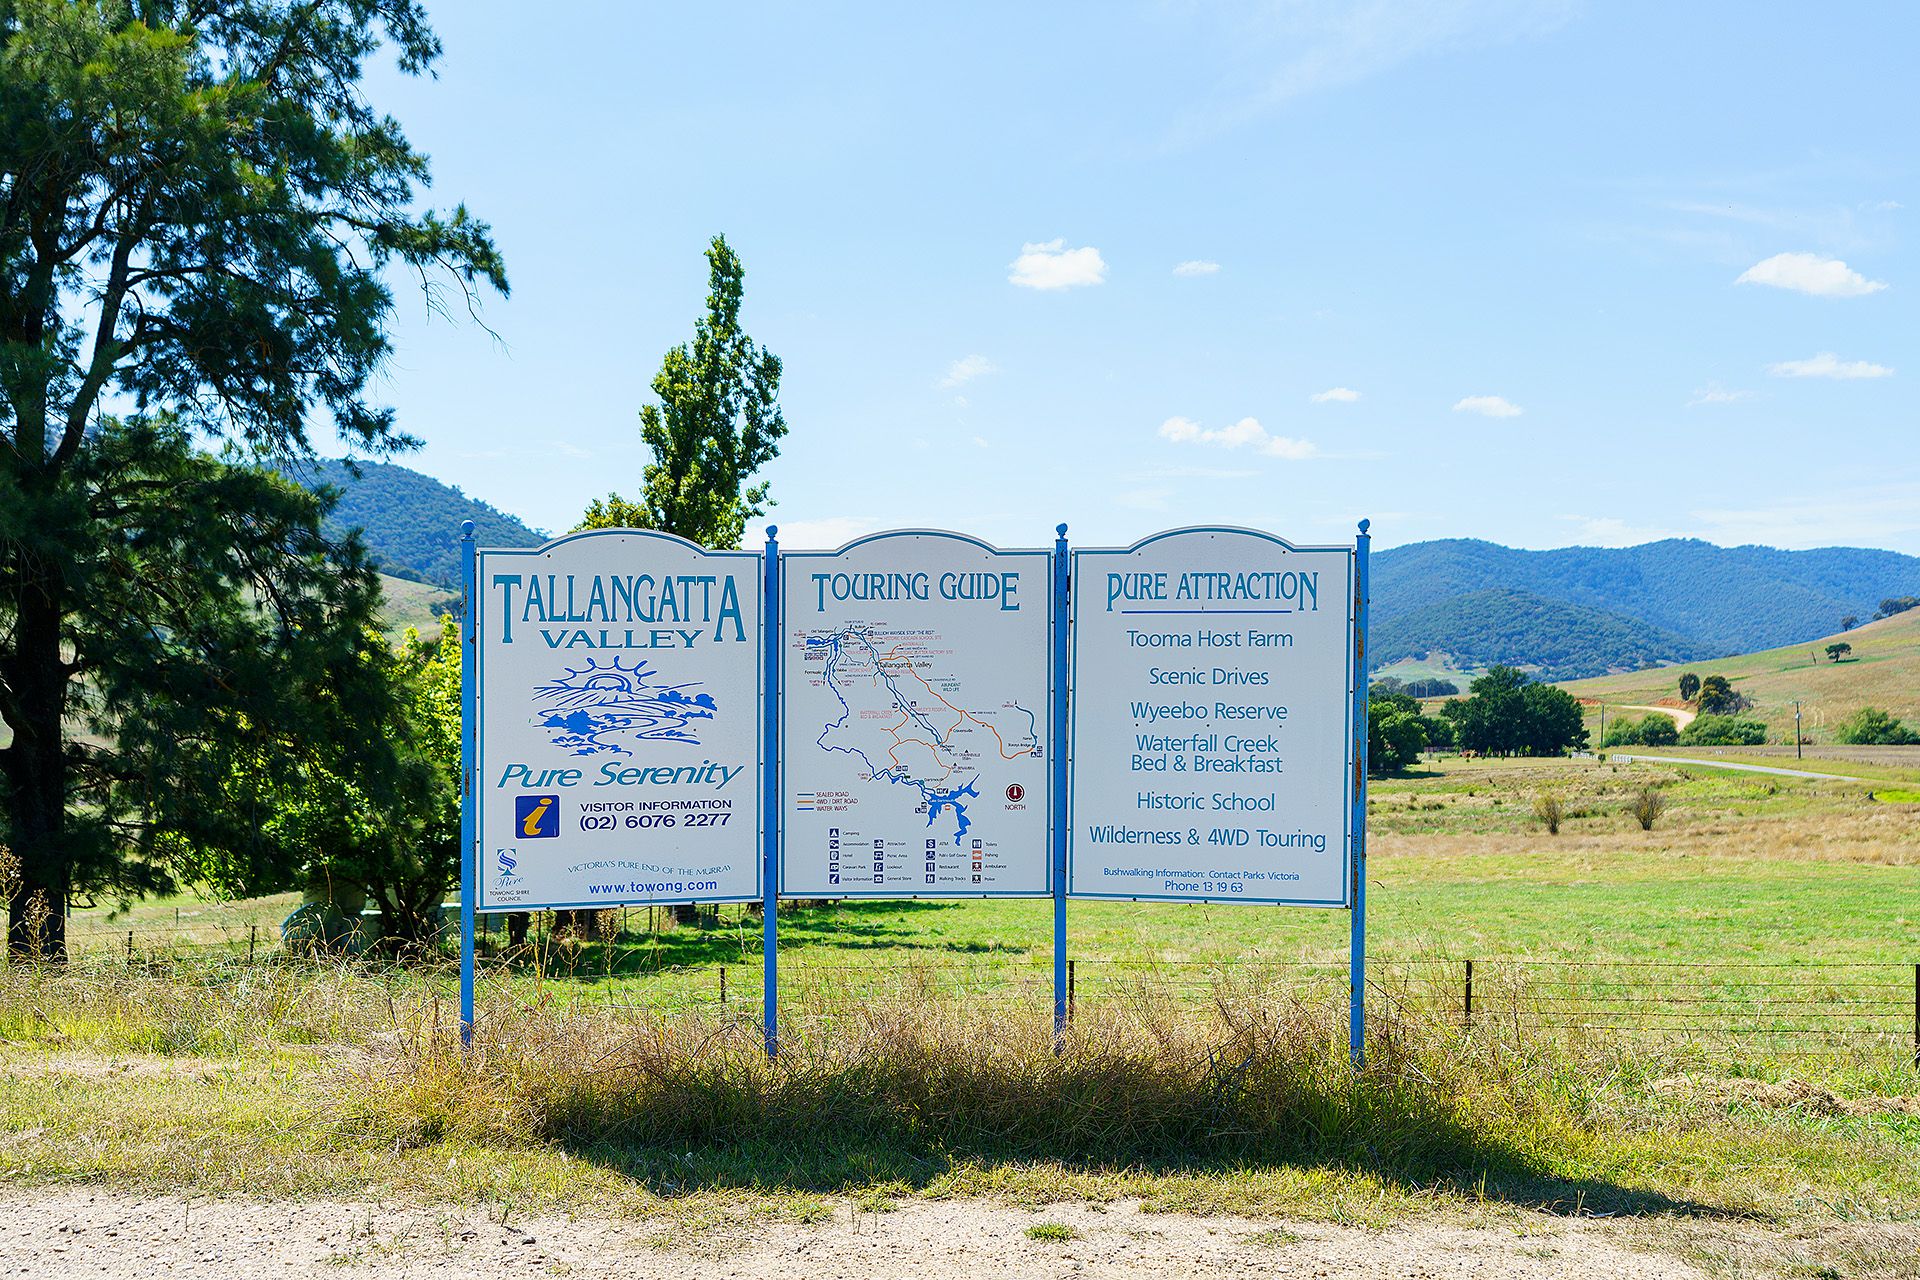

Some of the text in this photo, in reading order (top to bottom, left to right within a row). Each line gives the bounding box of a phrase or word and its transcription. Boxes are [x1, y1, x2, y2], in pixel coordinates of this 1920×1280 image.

[811, 572, 1020, 612] TOURING GUIDE
[1106, 571, 1319, 612] PURE ATTRACTION
[493, 574, 747, 643] TALLANGATTA
[540, 629, 704, 648] VALLEY
[1126, 630, 1294, 647] Tooma Host Farm
[914, 661, 932, 669] Valley
[1149, 667, 1270, 685] Scenic Drives
[1130, 701, 1288, 724] Wyeebo Reserve
[1135, 734, 1279, 752] Waterfall Creek
[1131, 754, 1283, 773] Bed & Breakfast
[497, 759, 744, 790] Pure Serenity
[580, 799, 732, 812] VISITOR INFORMATION
[1137, 791, 1275, 811] Historic School
[579, 813, 732, 832] (02) 6076 2277
[1089, 825, 1326, 853] Wilderness & 4WD Touring
[567, 860, 731, 876] VICTORIA'S PURE END OF THE MURRAY
[1103, 867, 1300, 881] Bushwalking Information: Contact Parks Victoria
[589, 880, 717, 894] www.towong.com
[1164, 880, 1243, 893] Phone 13 19 63
